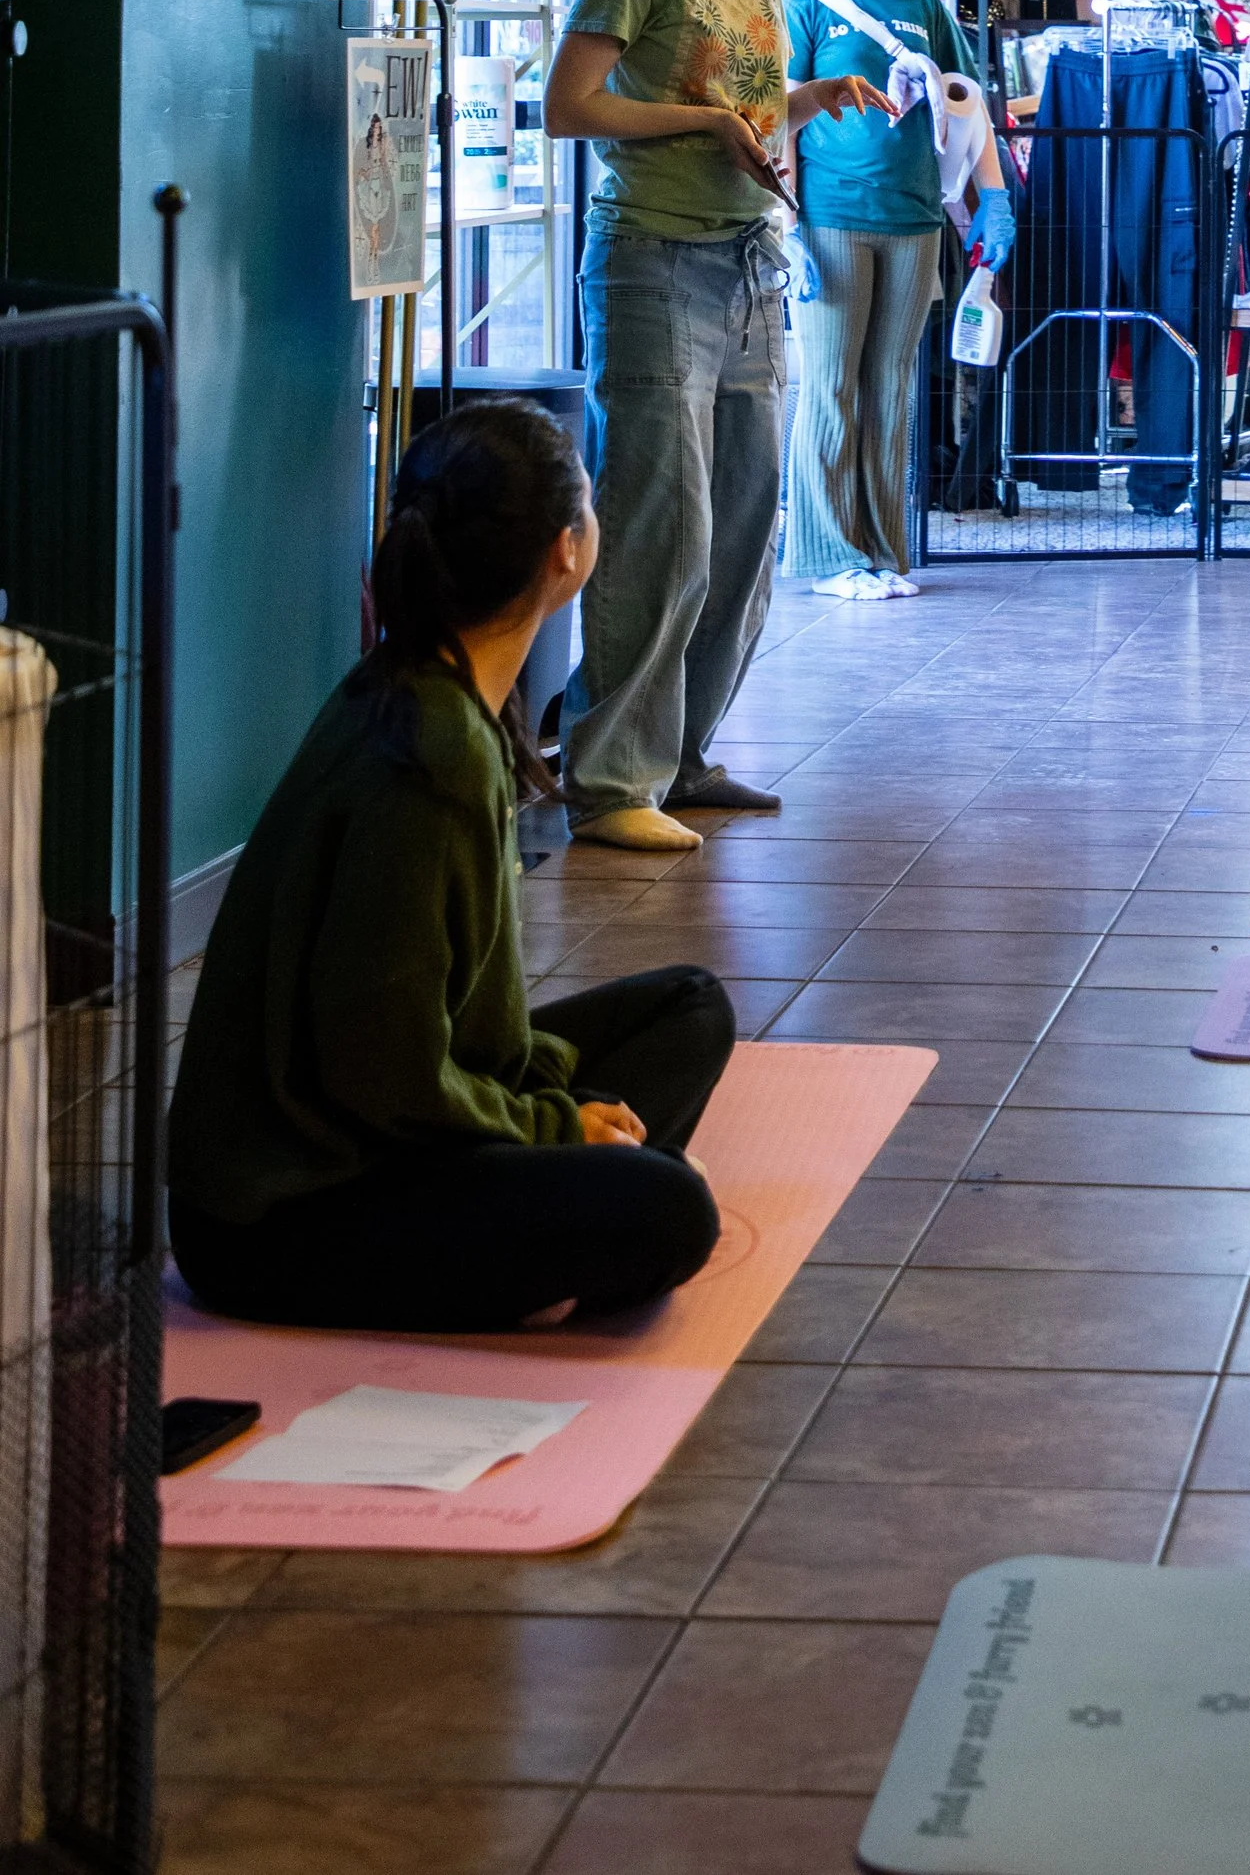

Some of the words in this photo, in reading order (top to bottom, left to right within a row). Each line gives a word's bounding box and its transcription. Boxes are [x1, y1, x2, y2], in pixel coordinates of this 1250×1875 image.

[828, 23, 849, 39] DO
[385, 51, 429, 121] EW!
[462, 99, 488, 108] white
